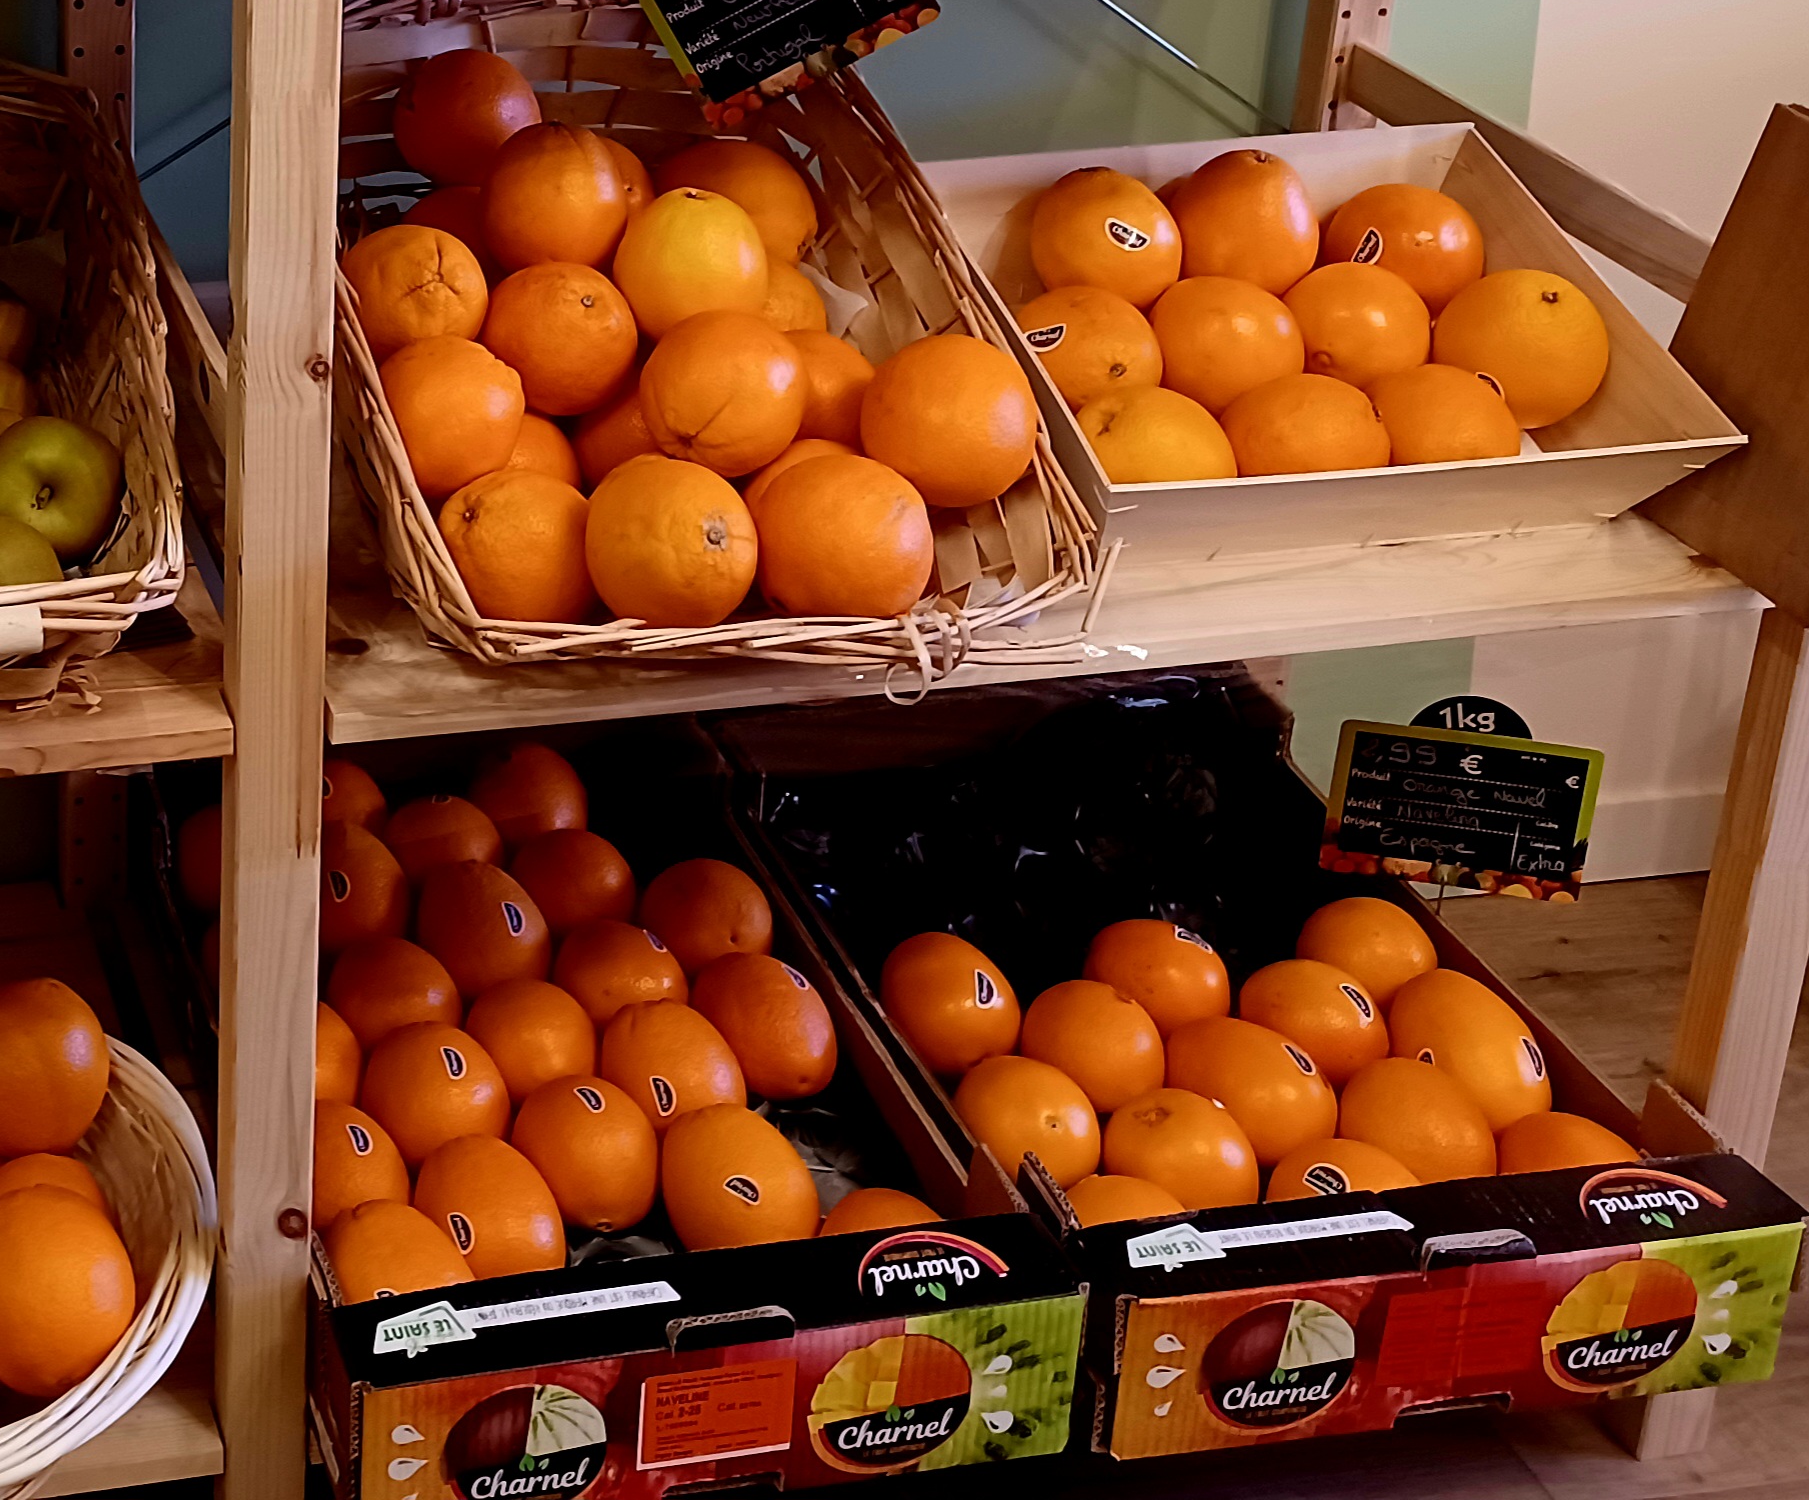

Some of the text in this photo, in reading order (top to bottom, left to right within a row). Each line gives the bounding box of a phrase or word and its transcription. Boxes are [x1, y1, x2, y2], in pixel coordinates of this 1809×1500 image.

[665, 0, 706, 24] Produit
[684, 30, 722, 56] Variété
[695, 50, 735, 75] Origine
[1439, 703, 1496, 733] 1kg
[1350, 767, 1391, 782] Produit
[1458, 754, 1484, 775] €
[1346, 797, 1382, 812] Variété
[1343, 814, 1383, 829] Origine
[1379, 828, 1476, 856] Espagne
[1589, 1189, 1700, 1225] Charnel
[1136, 1243, 1180, 1259] SAINT
[868, 1255, 981, 1297] Charnel
[383, 1319, 452, 1342] LE SAINT
[1568, 1328, 1679, 1370] Charnel
[1222, 1371, 1337, 1410] Charnel
[838, 1407, 954, 1450] Charnel
[470, 1457, 591, 1499] Charnel
